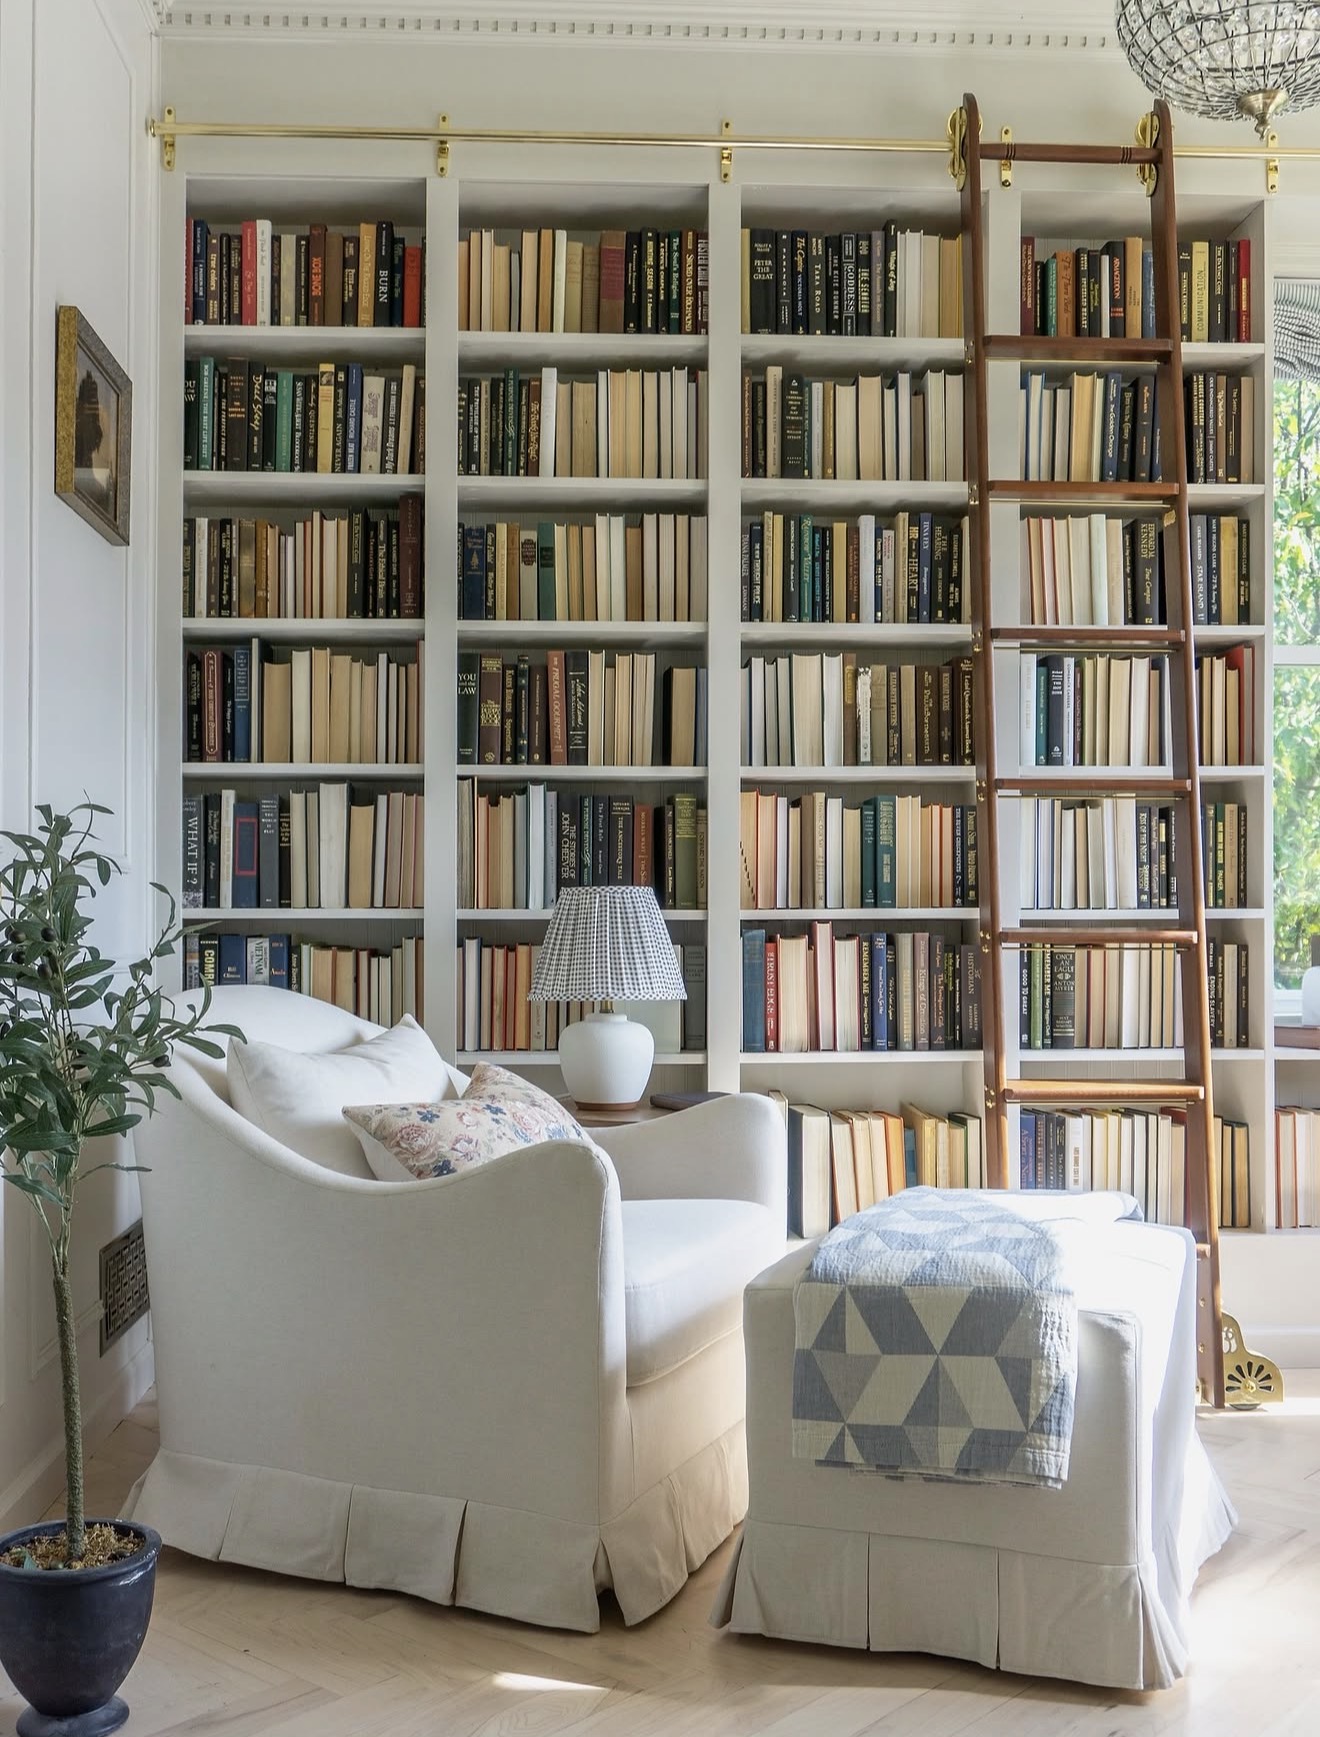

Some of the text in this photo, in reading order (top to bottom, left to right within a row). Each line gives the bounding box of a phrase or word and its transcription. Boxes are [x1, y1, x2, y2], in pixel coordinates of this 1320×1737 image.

[210, 269, 218, 290] colors
[379, 270, 388, 302] BURN
[250, 374, 262, 430] Dead Sleep
[910, 526, 918, 539] HR
[909, 559, 918, 591] HEART
[576, 678, 586, 726] John Adams
[188, 817, 197, 858] WHAT
[1139, 845, 1148, 862] NIGHT
[188, 862, 196, 874] IF
[570, 869, 575, 879] OF
[863, 983, 869, 994] ME
